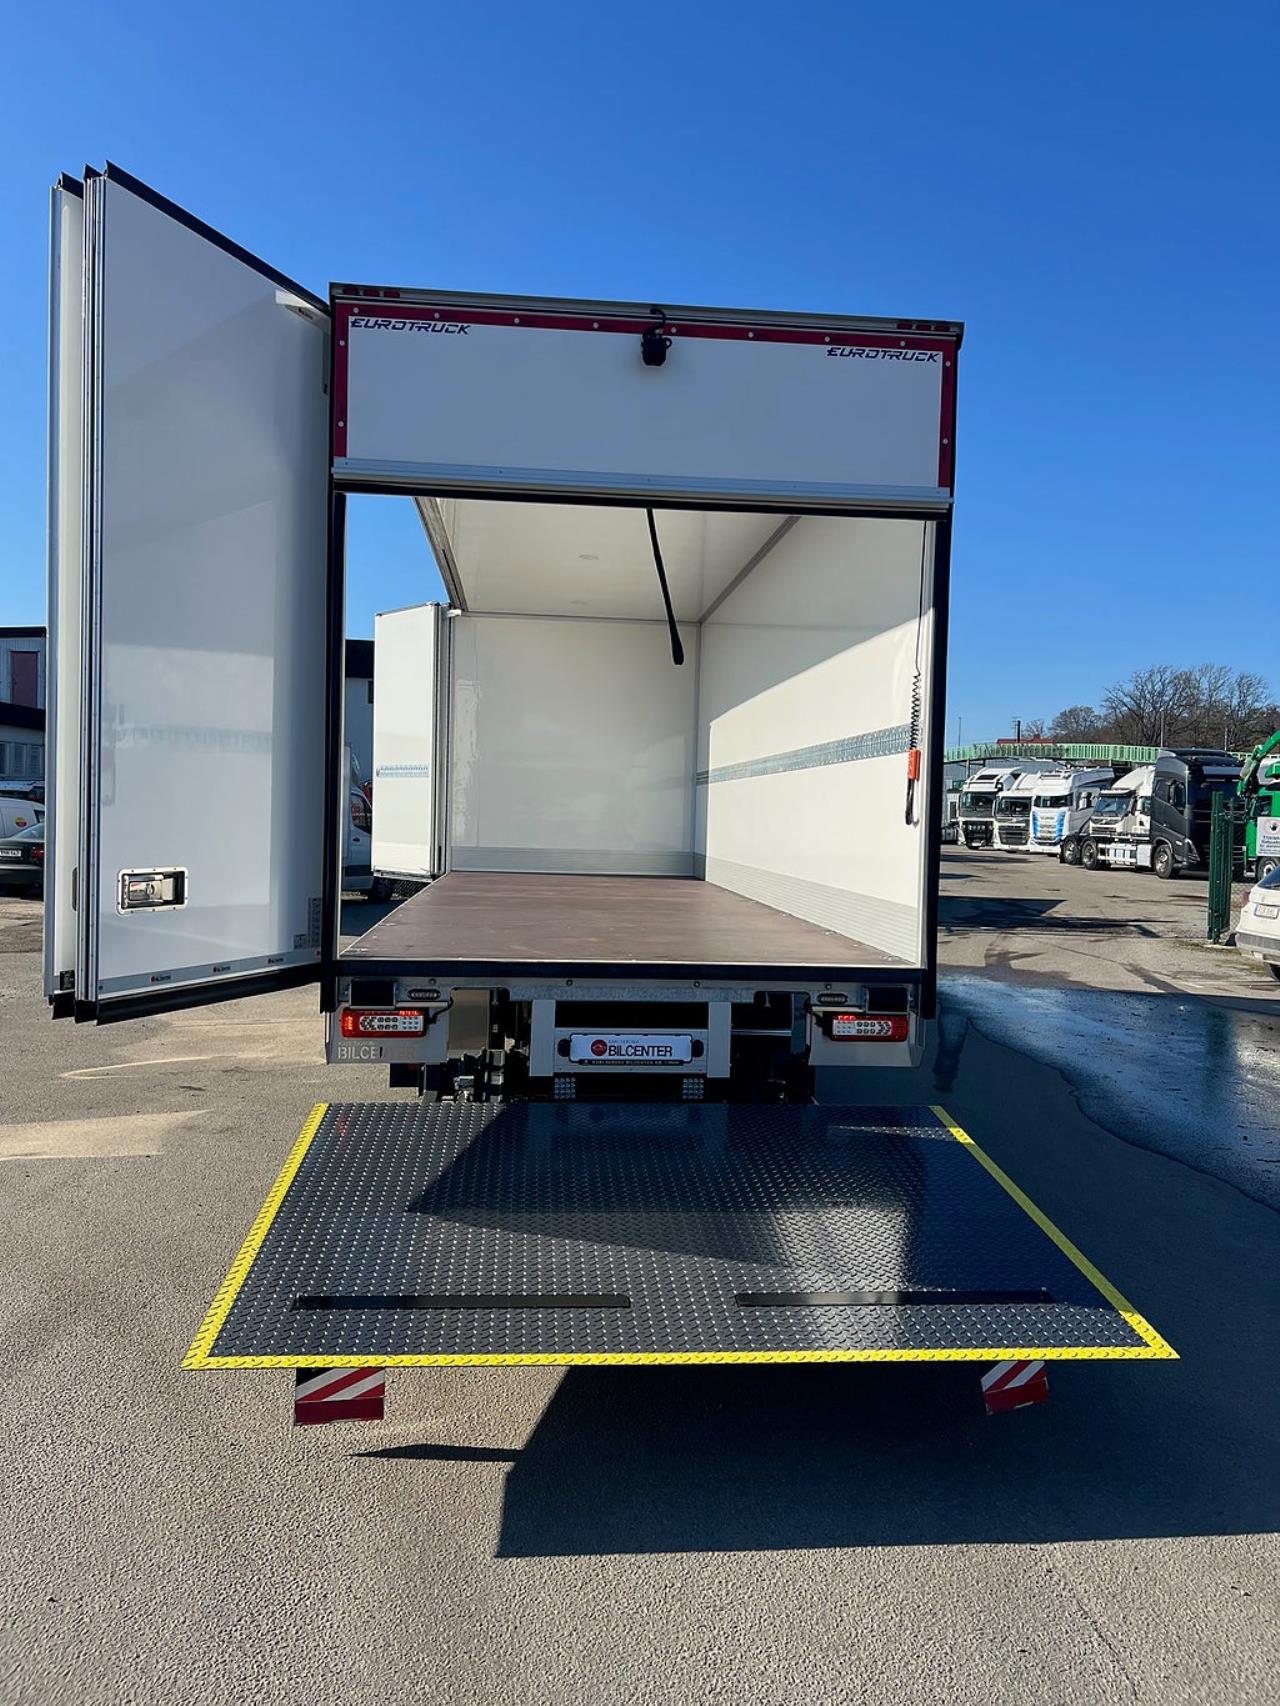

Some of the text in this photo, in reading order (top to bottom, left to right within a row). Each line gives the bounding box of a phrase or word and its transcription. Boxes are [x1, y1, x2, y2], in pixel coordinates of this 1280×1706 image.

[350, 318, 471, 335] EUROTRUCK
[827, 347, 940, 363] EUROTRUCK
[608, 1045, 673, 1057] BILCENTER
